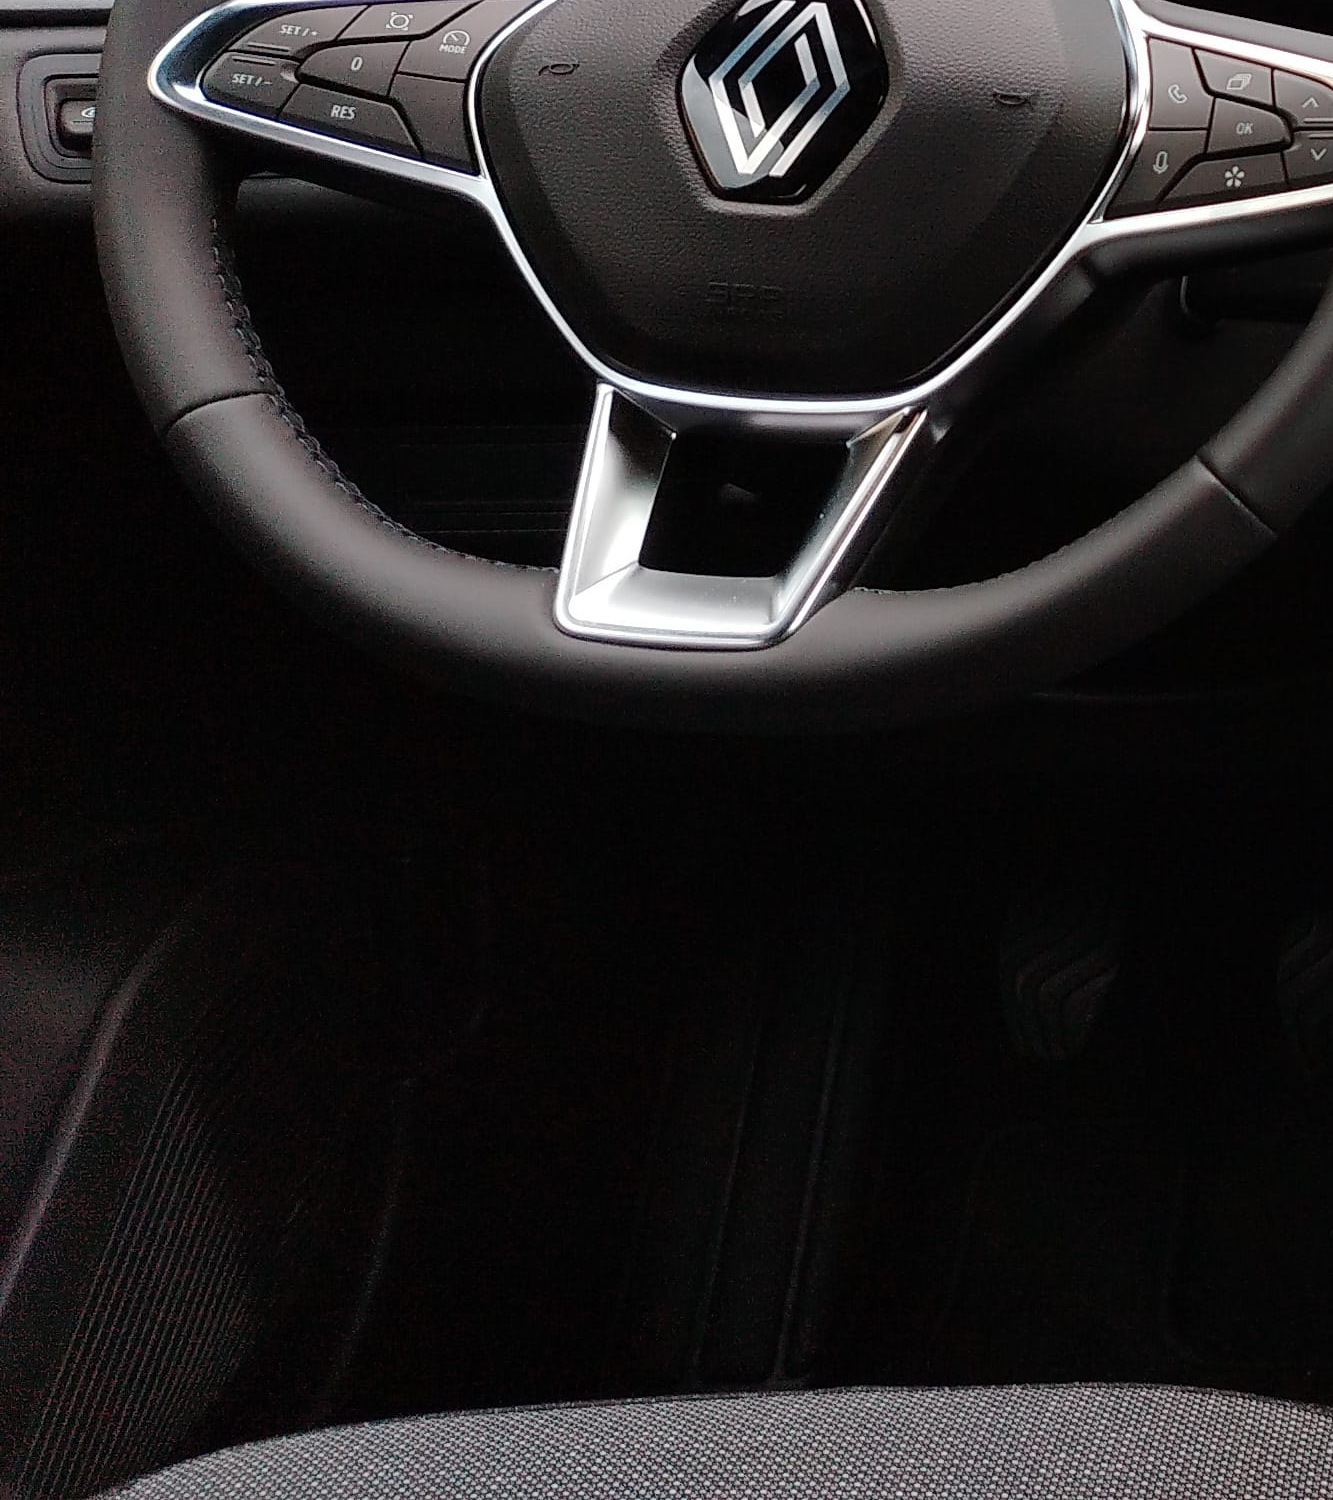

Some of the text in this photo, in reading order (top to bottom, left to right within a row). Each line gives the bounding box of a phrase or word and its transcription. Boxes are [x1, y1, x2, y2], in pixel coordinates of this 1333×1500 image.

[439, 44, 467, 54] MODE
[330, 105, 357, 120] RES
[1236, 122, 1254, 135] OK
